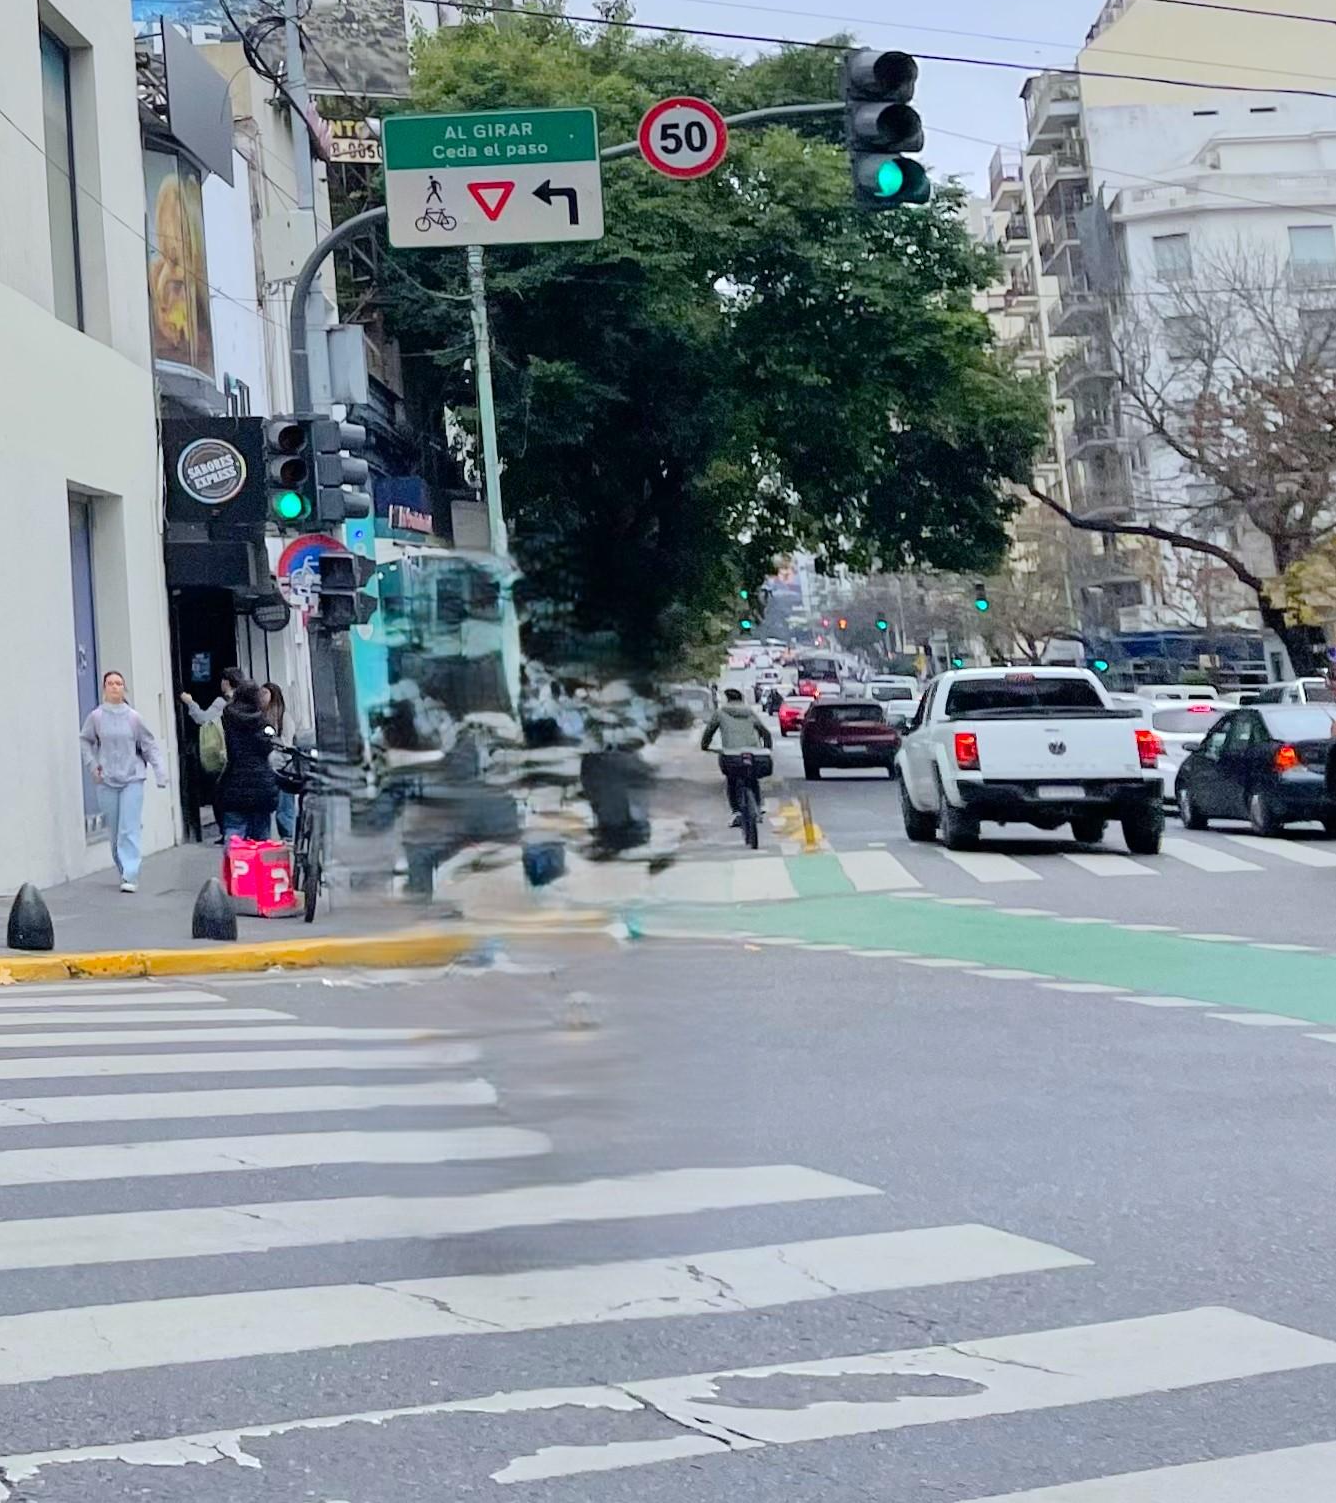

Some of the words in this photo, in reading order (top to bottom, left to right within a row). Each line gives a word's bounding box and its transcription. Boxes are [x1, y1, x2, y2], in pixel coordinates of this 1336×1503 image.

[444, 125, 467, 140] AL
[473, 122, 533, 138] GIRAR
[660, 121, 707, 155] 50
[433, 144, 477, 160] Ceda
[483, 143, 500, 157] el
[506, 144, 548, 160] paso
[188, 454, 234, 480] SABORES
[194, 466, 237, 490] EXPRESS
